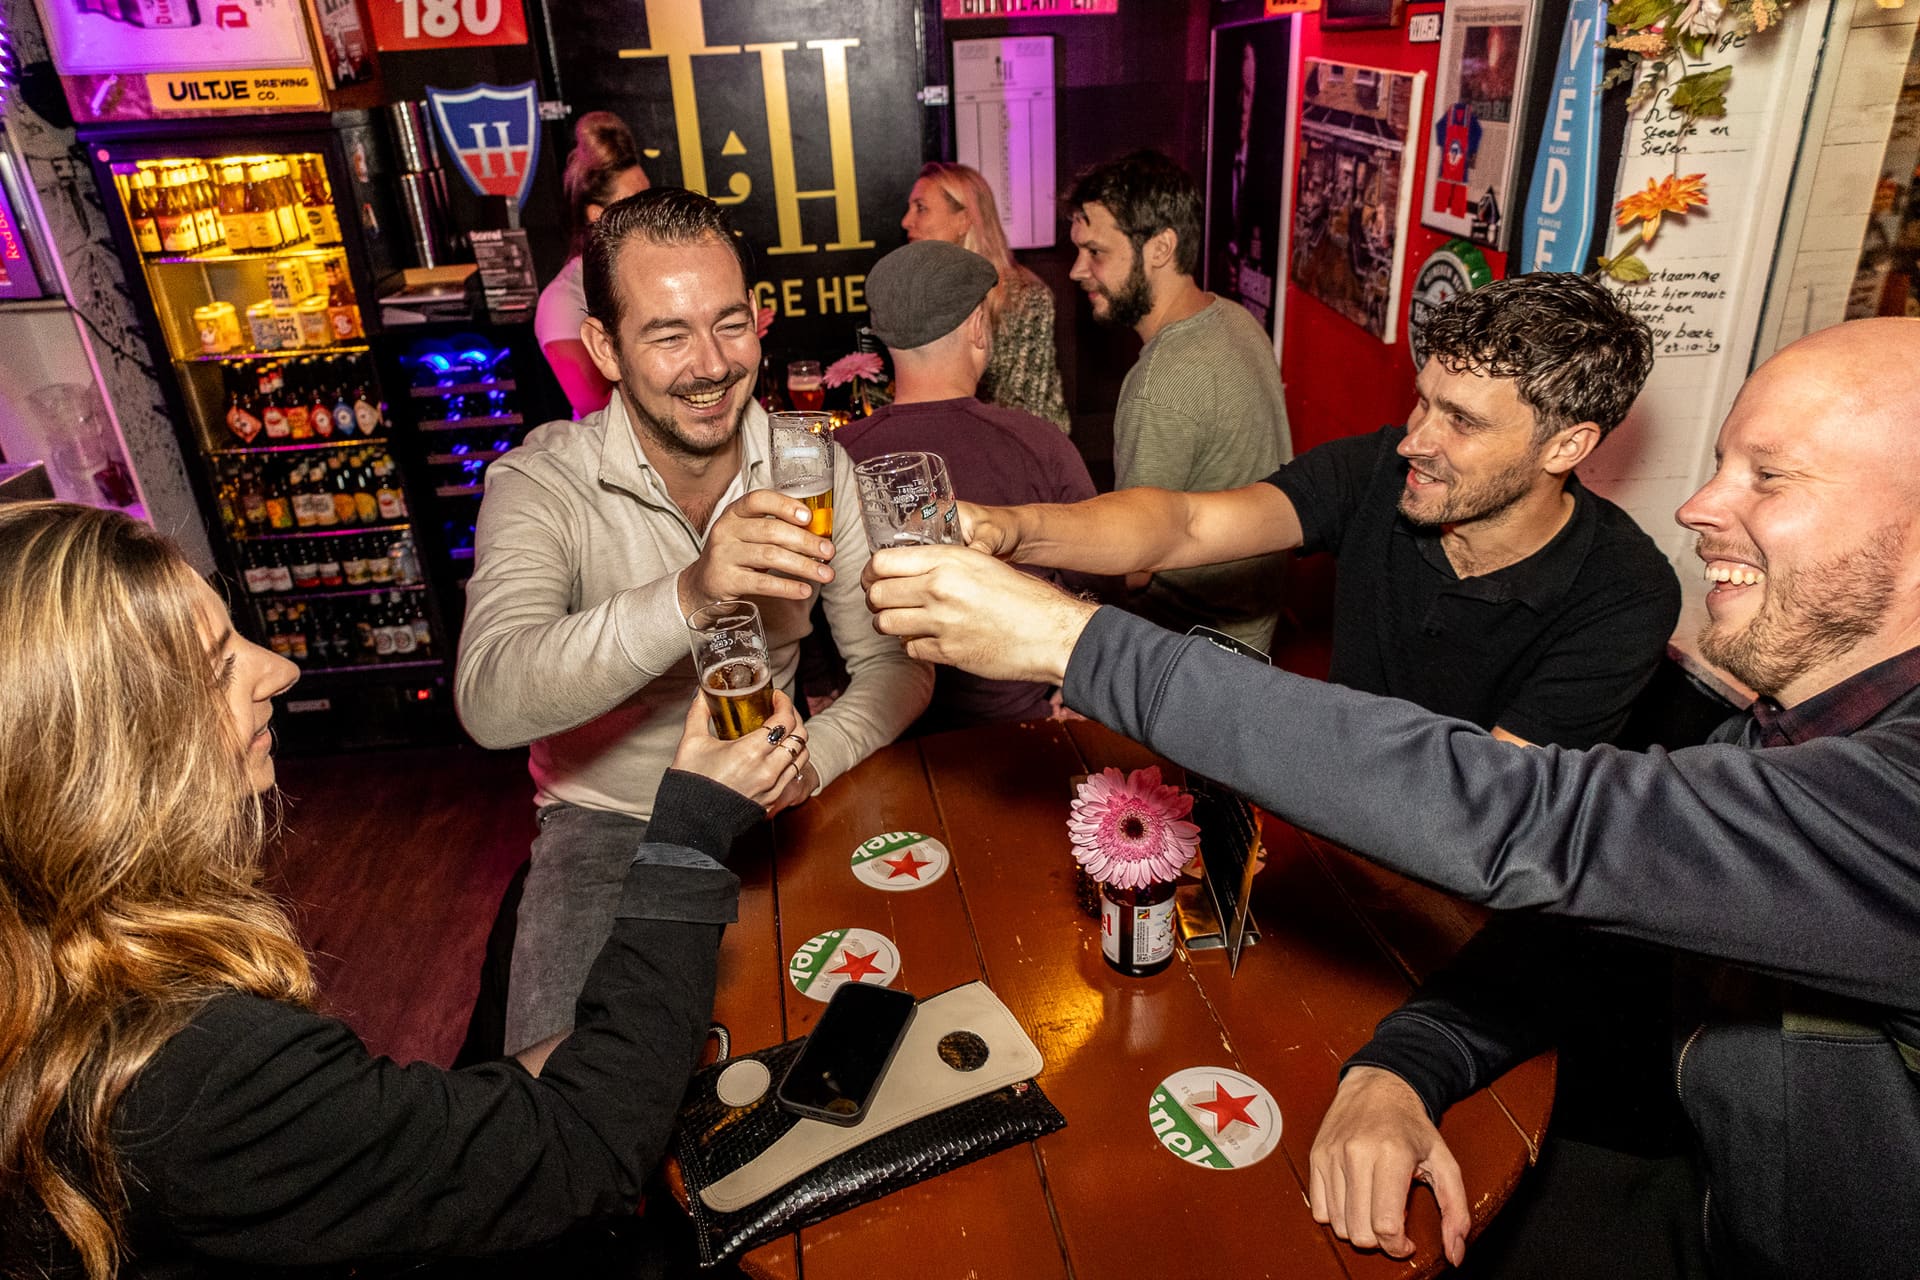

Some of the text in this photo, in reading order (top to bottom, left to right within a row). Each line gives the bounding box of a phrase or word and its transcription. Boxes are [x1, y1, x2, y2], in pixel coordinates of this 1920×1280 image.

[395, 0, 502, 39] 180
[168, 77, 310, 101] UILTJE BREWING
[257, 91, 279, 101] CO.
[1533, 18, 1592, 273] VEDE
[0, 231, 20, 259] Red
[754, 274, 868, 318] GE HE
